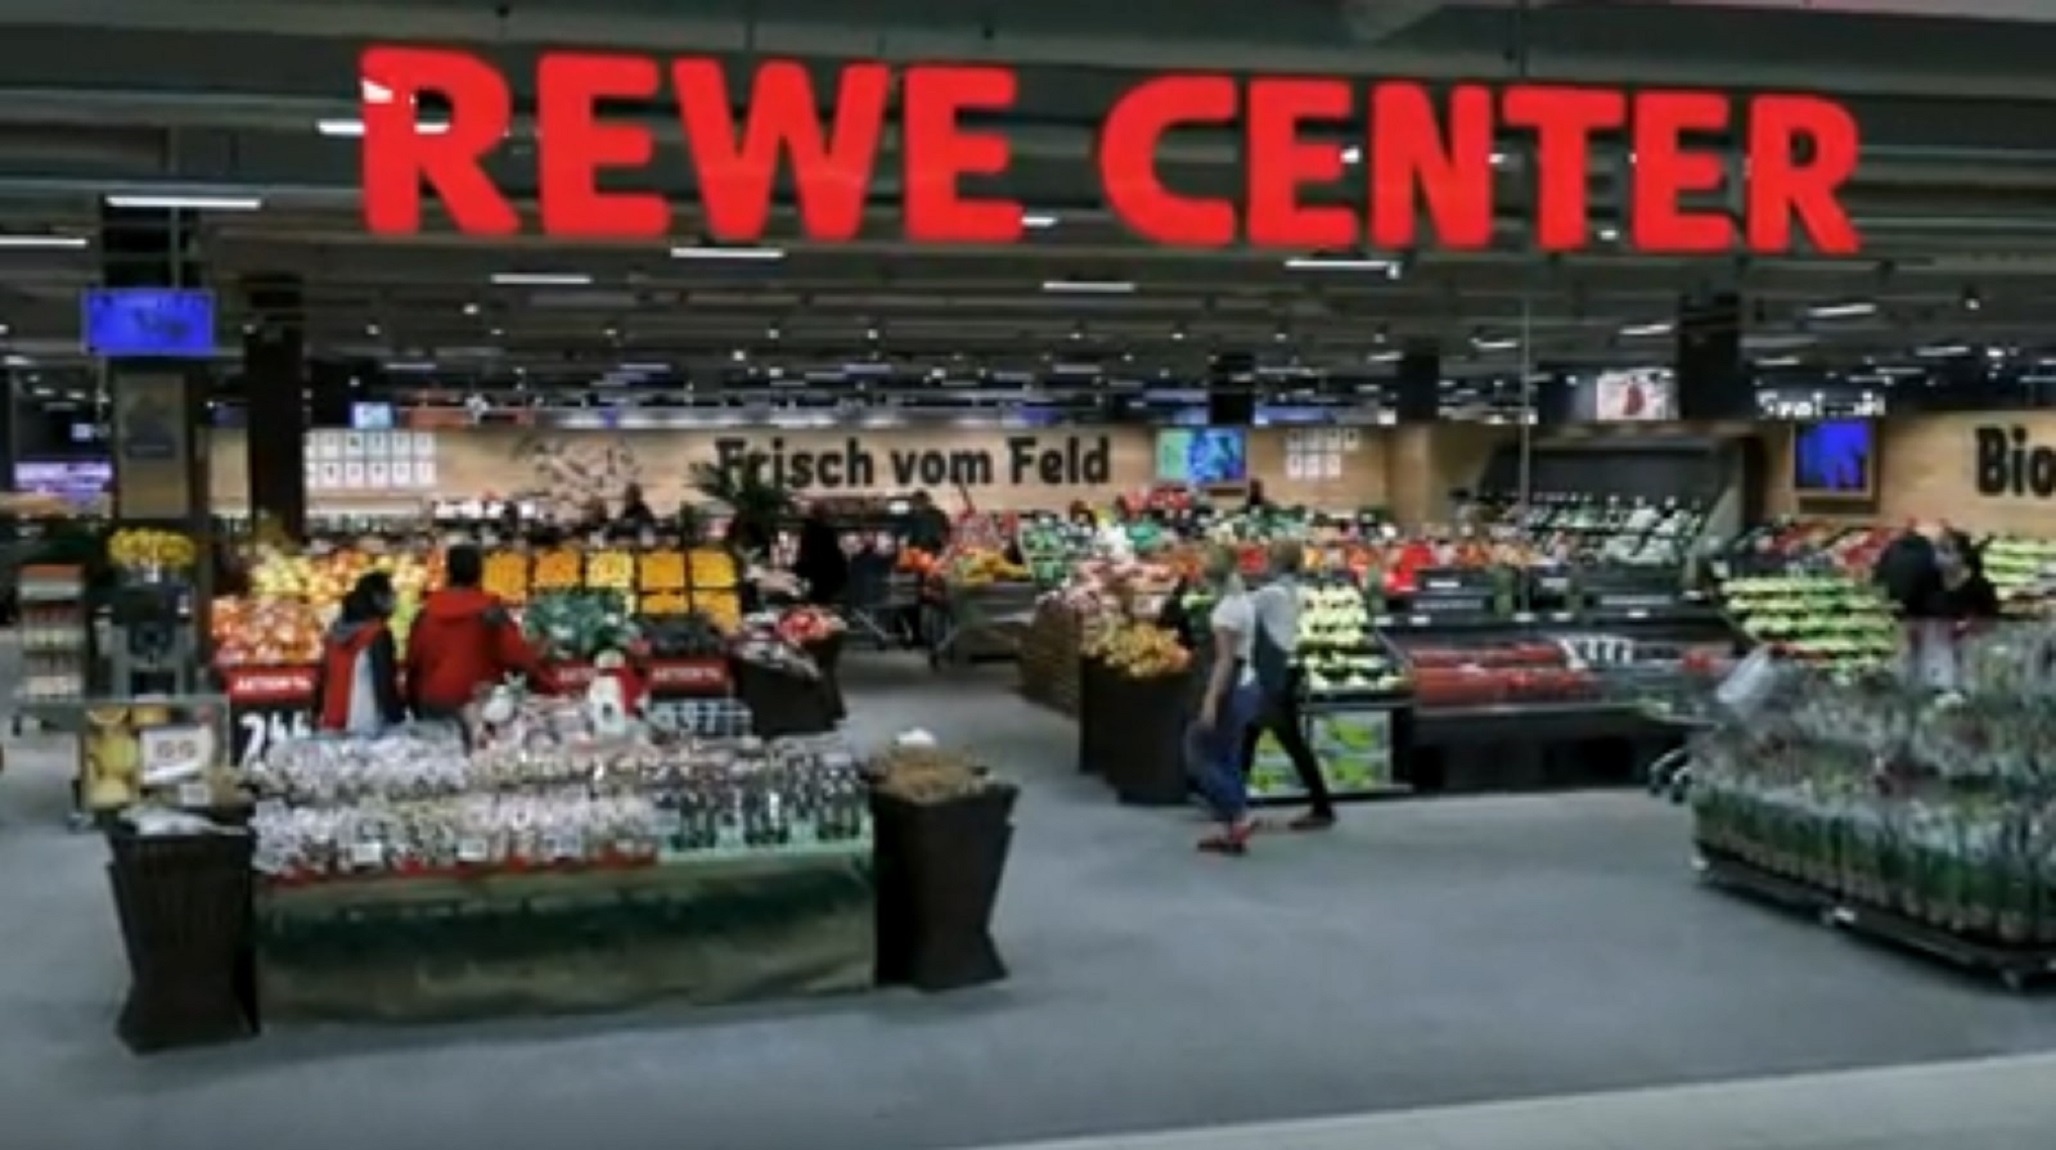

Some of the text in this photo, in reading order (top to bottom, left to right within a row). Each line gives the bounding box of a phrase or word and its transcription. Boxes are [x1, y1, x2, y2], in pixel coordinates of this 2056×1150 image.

[360, 47, 1860, 253] REWE CENTER
[714, 435, 1111, 488] Frisch vom Feld
[1975, 424, 2056, 500] Bio
